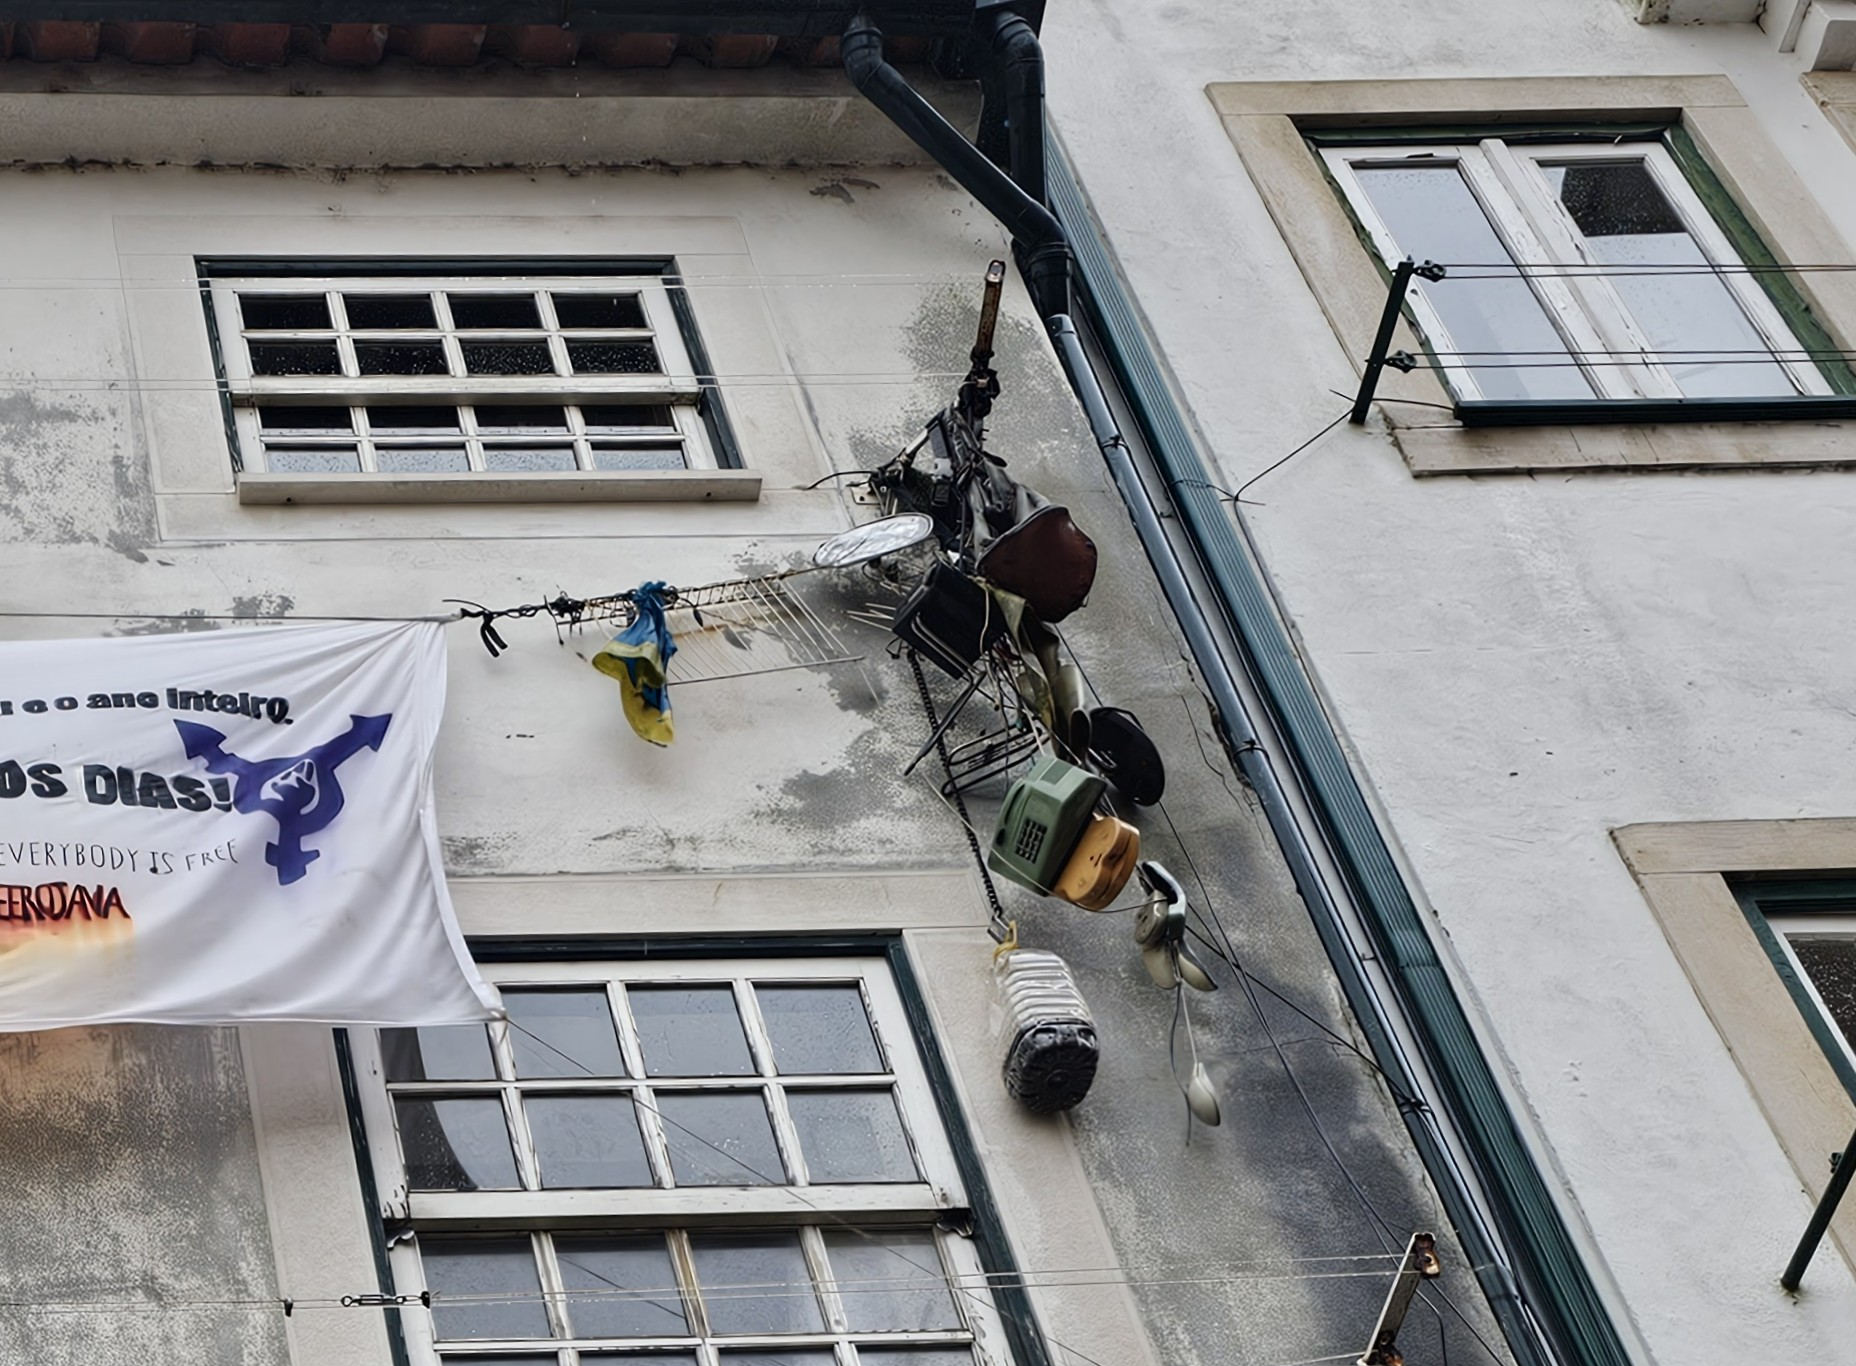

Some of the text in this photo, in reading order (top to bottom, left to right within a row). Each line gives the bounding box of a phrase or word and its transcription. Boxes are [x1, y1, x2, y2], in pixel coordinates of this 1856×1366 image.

[22, 699, 49, 715] e
[54, 696, 79, 710] o
[86, 688, 159, 709] ano
[83, 763, 234, 812] DIAS!
[150, 850, 174, 875] IS
[185, 839, 238, 872] FREE
